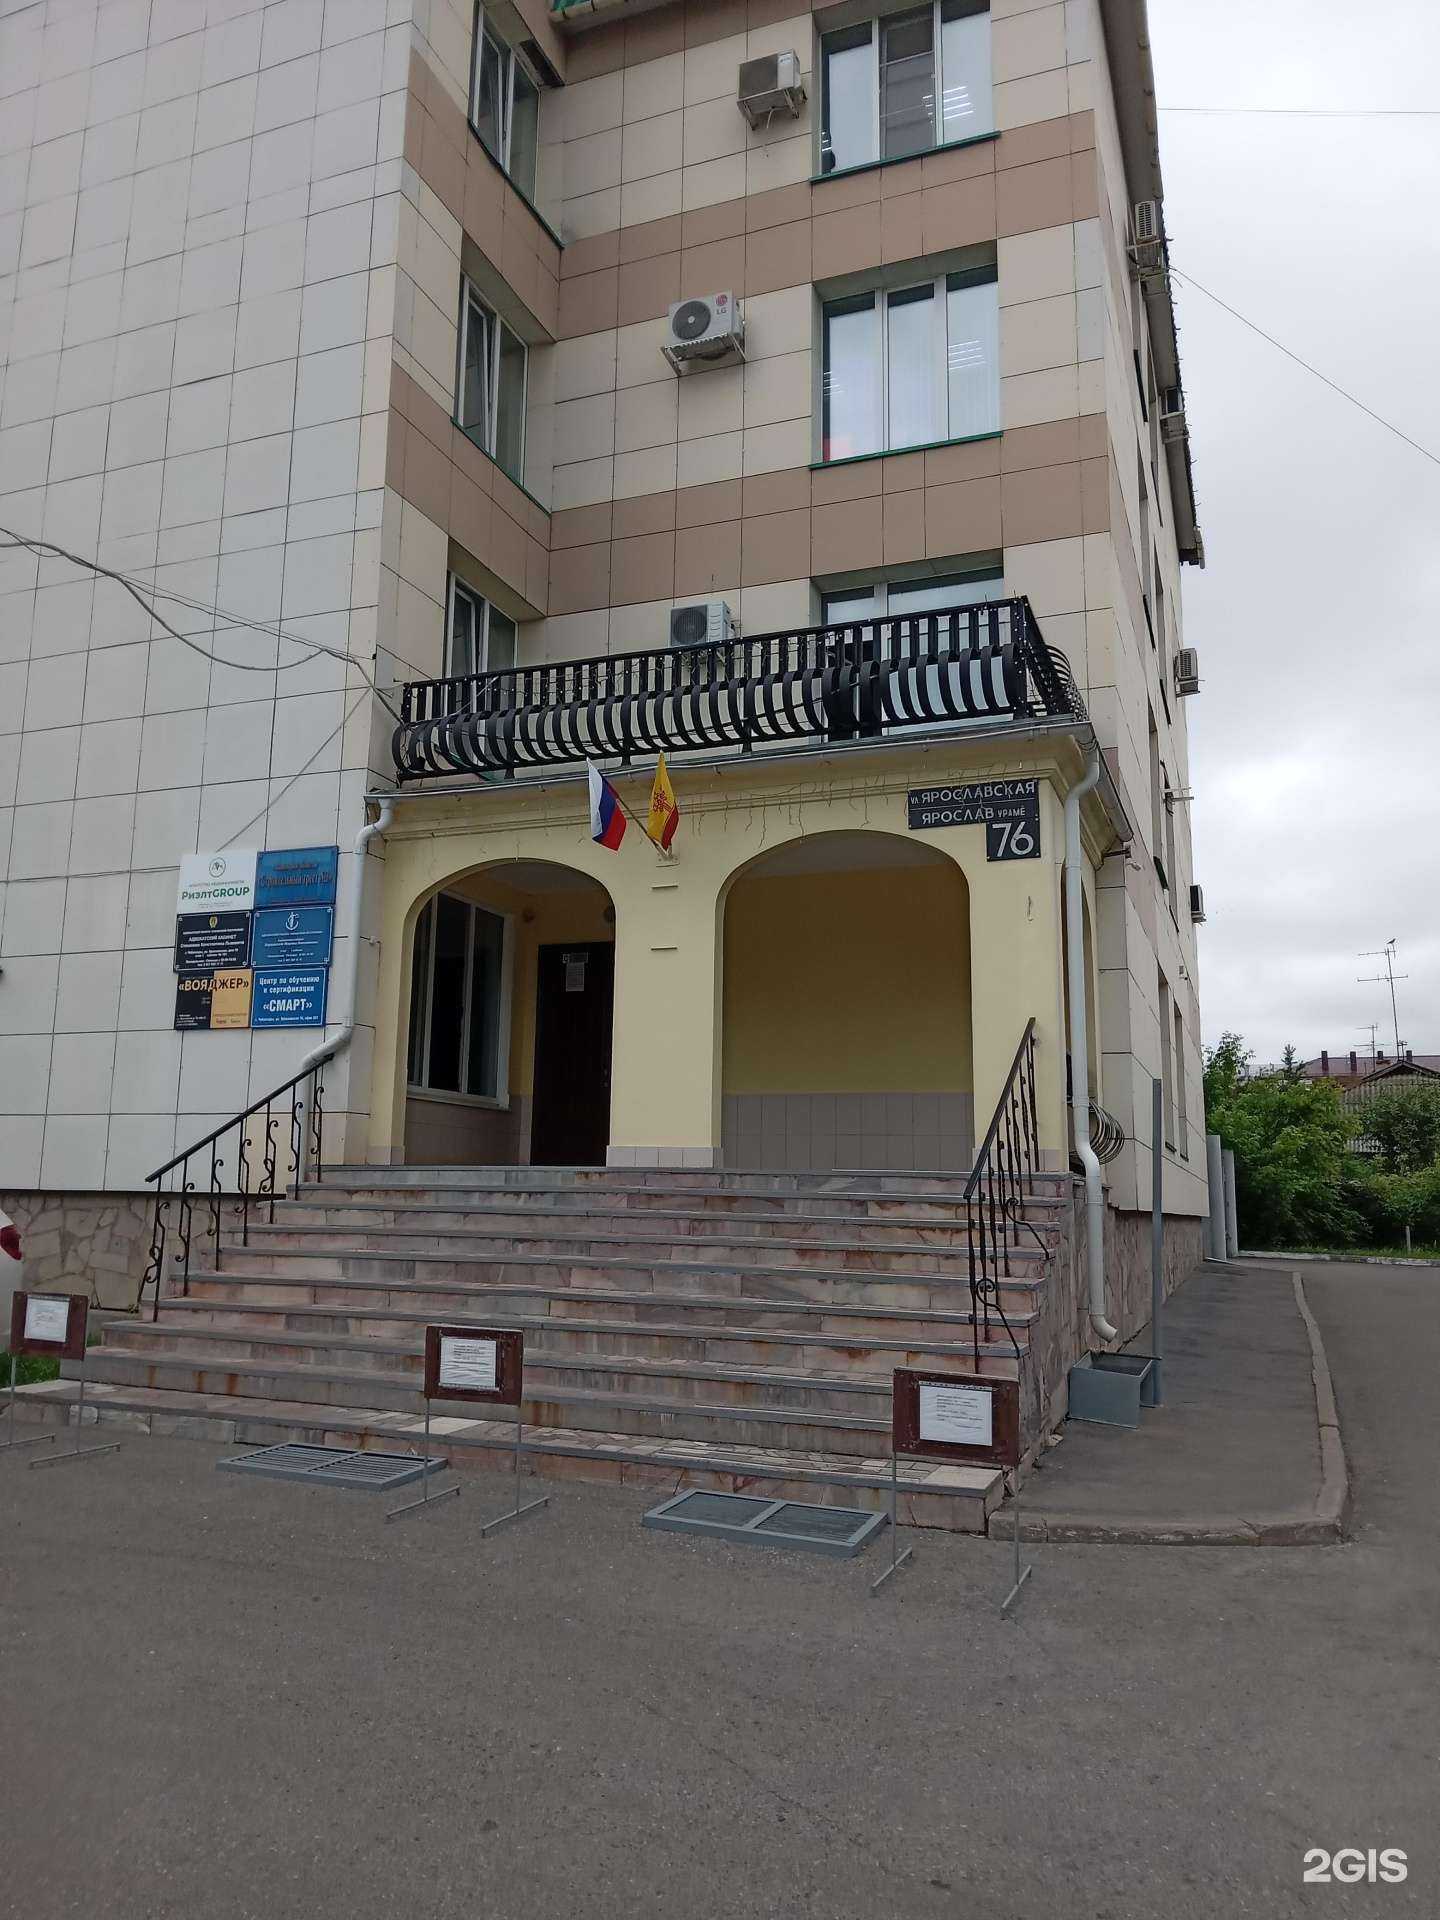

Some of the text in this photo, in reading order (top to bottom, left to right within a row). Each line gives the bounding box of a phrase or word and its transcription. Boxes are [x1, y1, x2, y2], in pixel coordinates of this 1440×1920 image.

[716, 307, 727, 315] LG
[921, 781, 1035, 804] ЯРОСЛАВСКАЯ
[922, 807, 994, 825] ЯРОСЛАВ
[992, 821, 1034, 857] 76
[182, 887, 250, 900] РиэлтGROUP
[178, 977, 249, 992] «ВОЯДЖЕР»
[260, 977, 278, 986] Центр
[289, 976, 320, 985] обучению
[270, 985, 315, 994] сертификации
[263, 998, 313, 1012] «СМАРТ»
